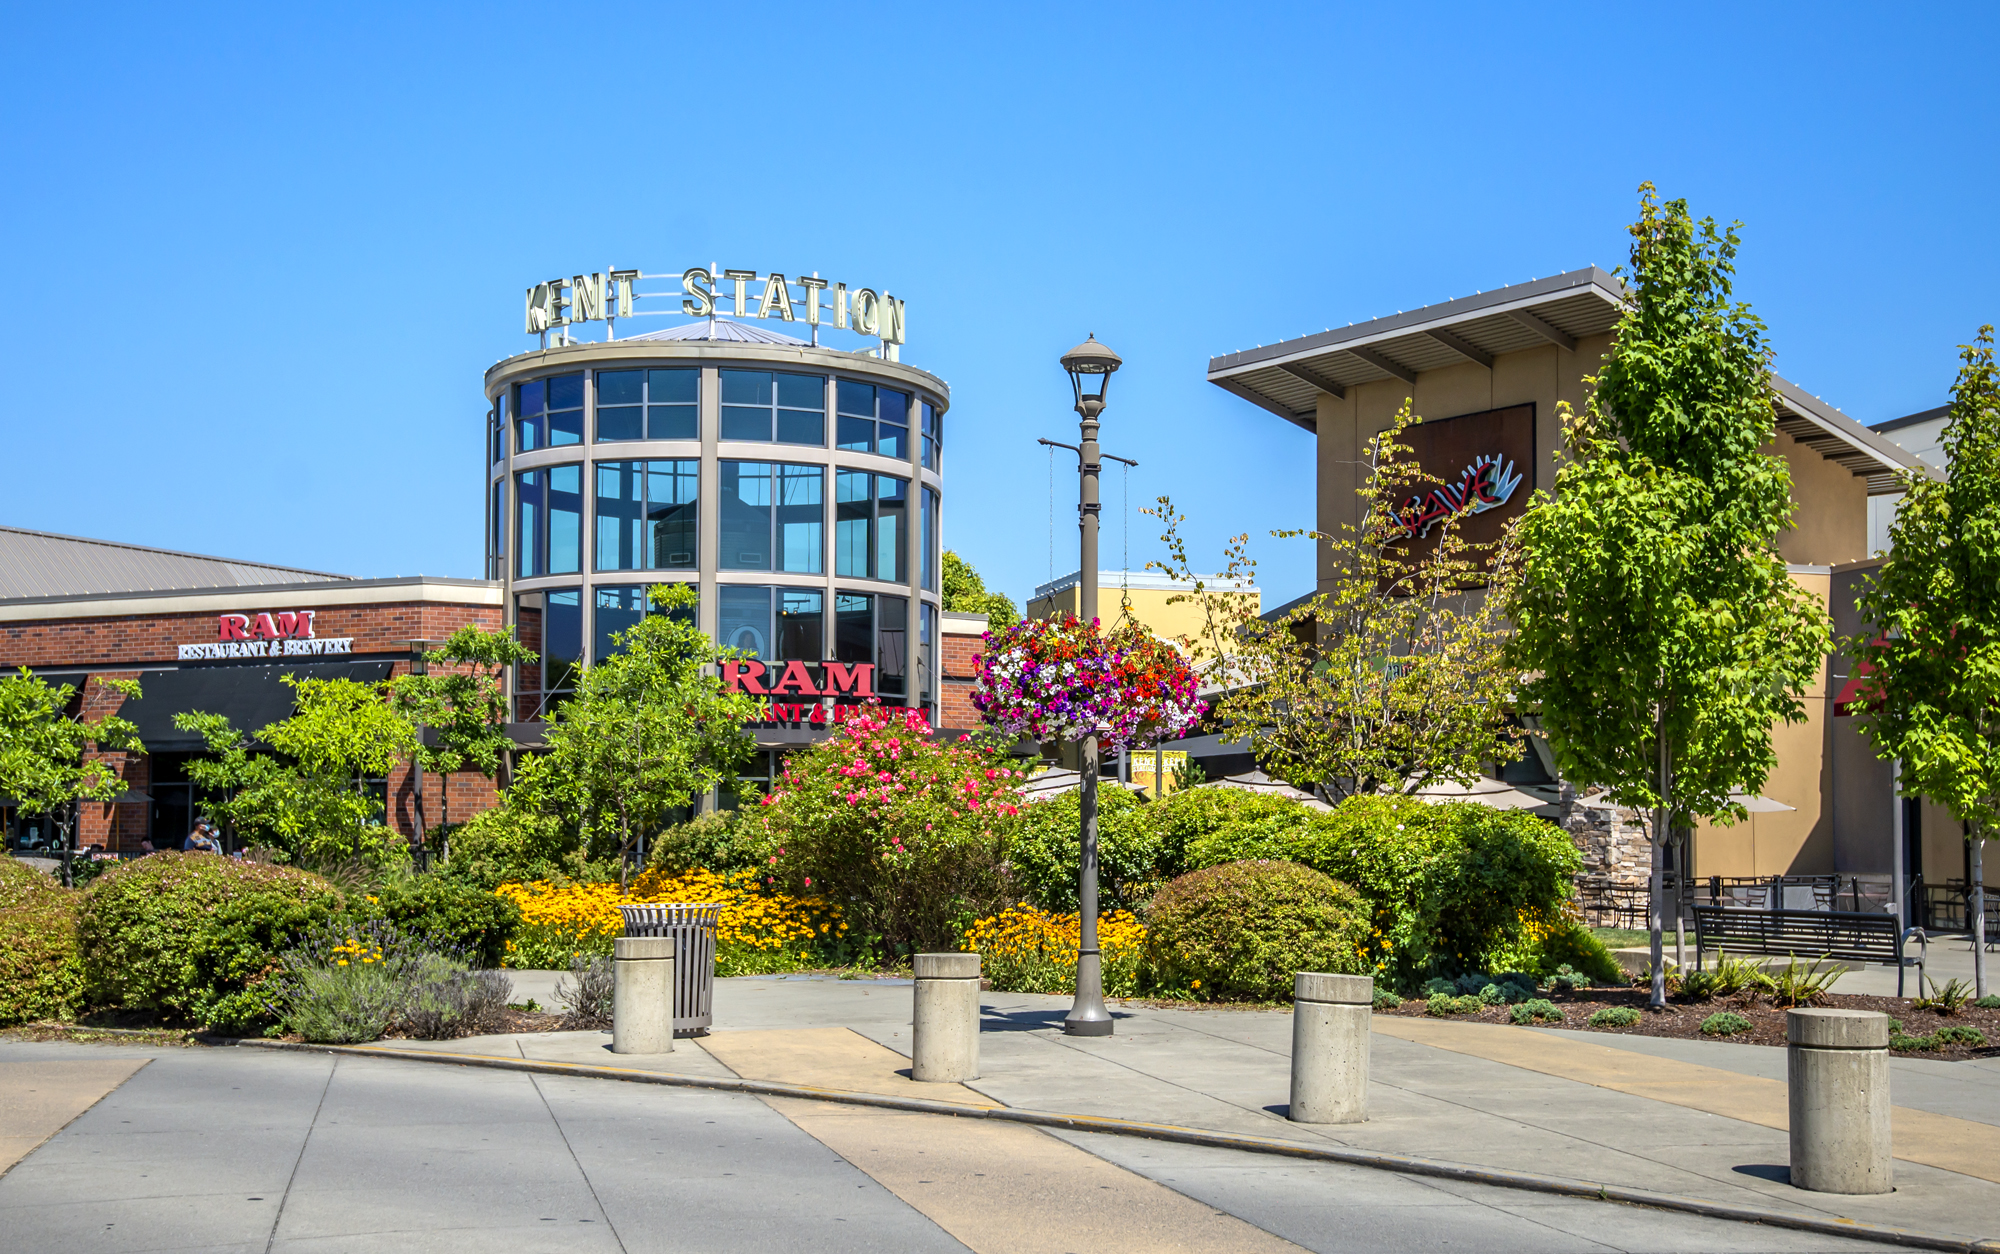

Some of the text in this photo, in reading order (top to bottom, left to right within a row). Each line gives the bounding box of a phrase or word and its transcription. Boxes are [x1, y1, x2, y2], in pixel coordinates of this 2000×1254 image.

[525, 267, 906, 345] KENT STATION
[218, 610, 316, 642] RAM
[178, 637, 354, 660] RESTAURANT & BREWERY
[717, 658, 875, 698] RAM
[808, 703, 828, 723] &
[1133, 757, 1157, 767] KENT
